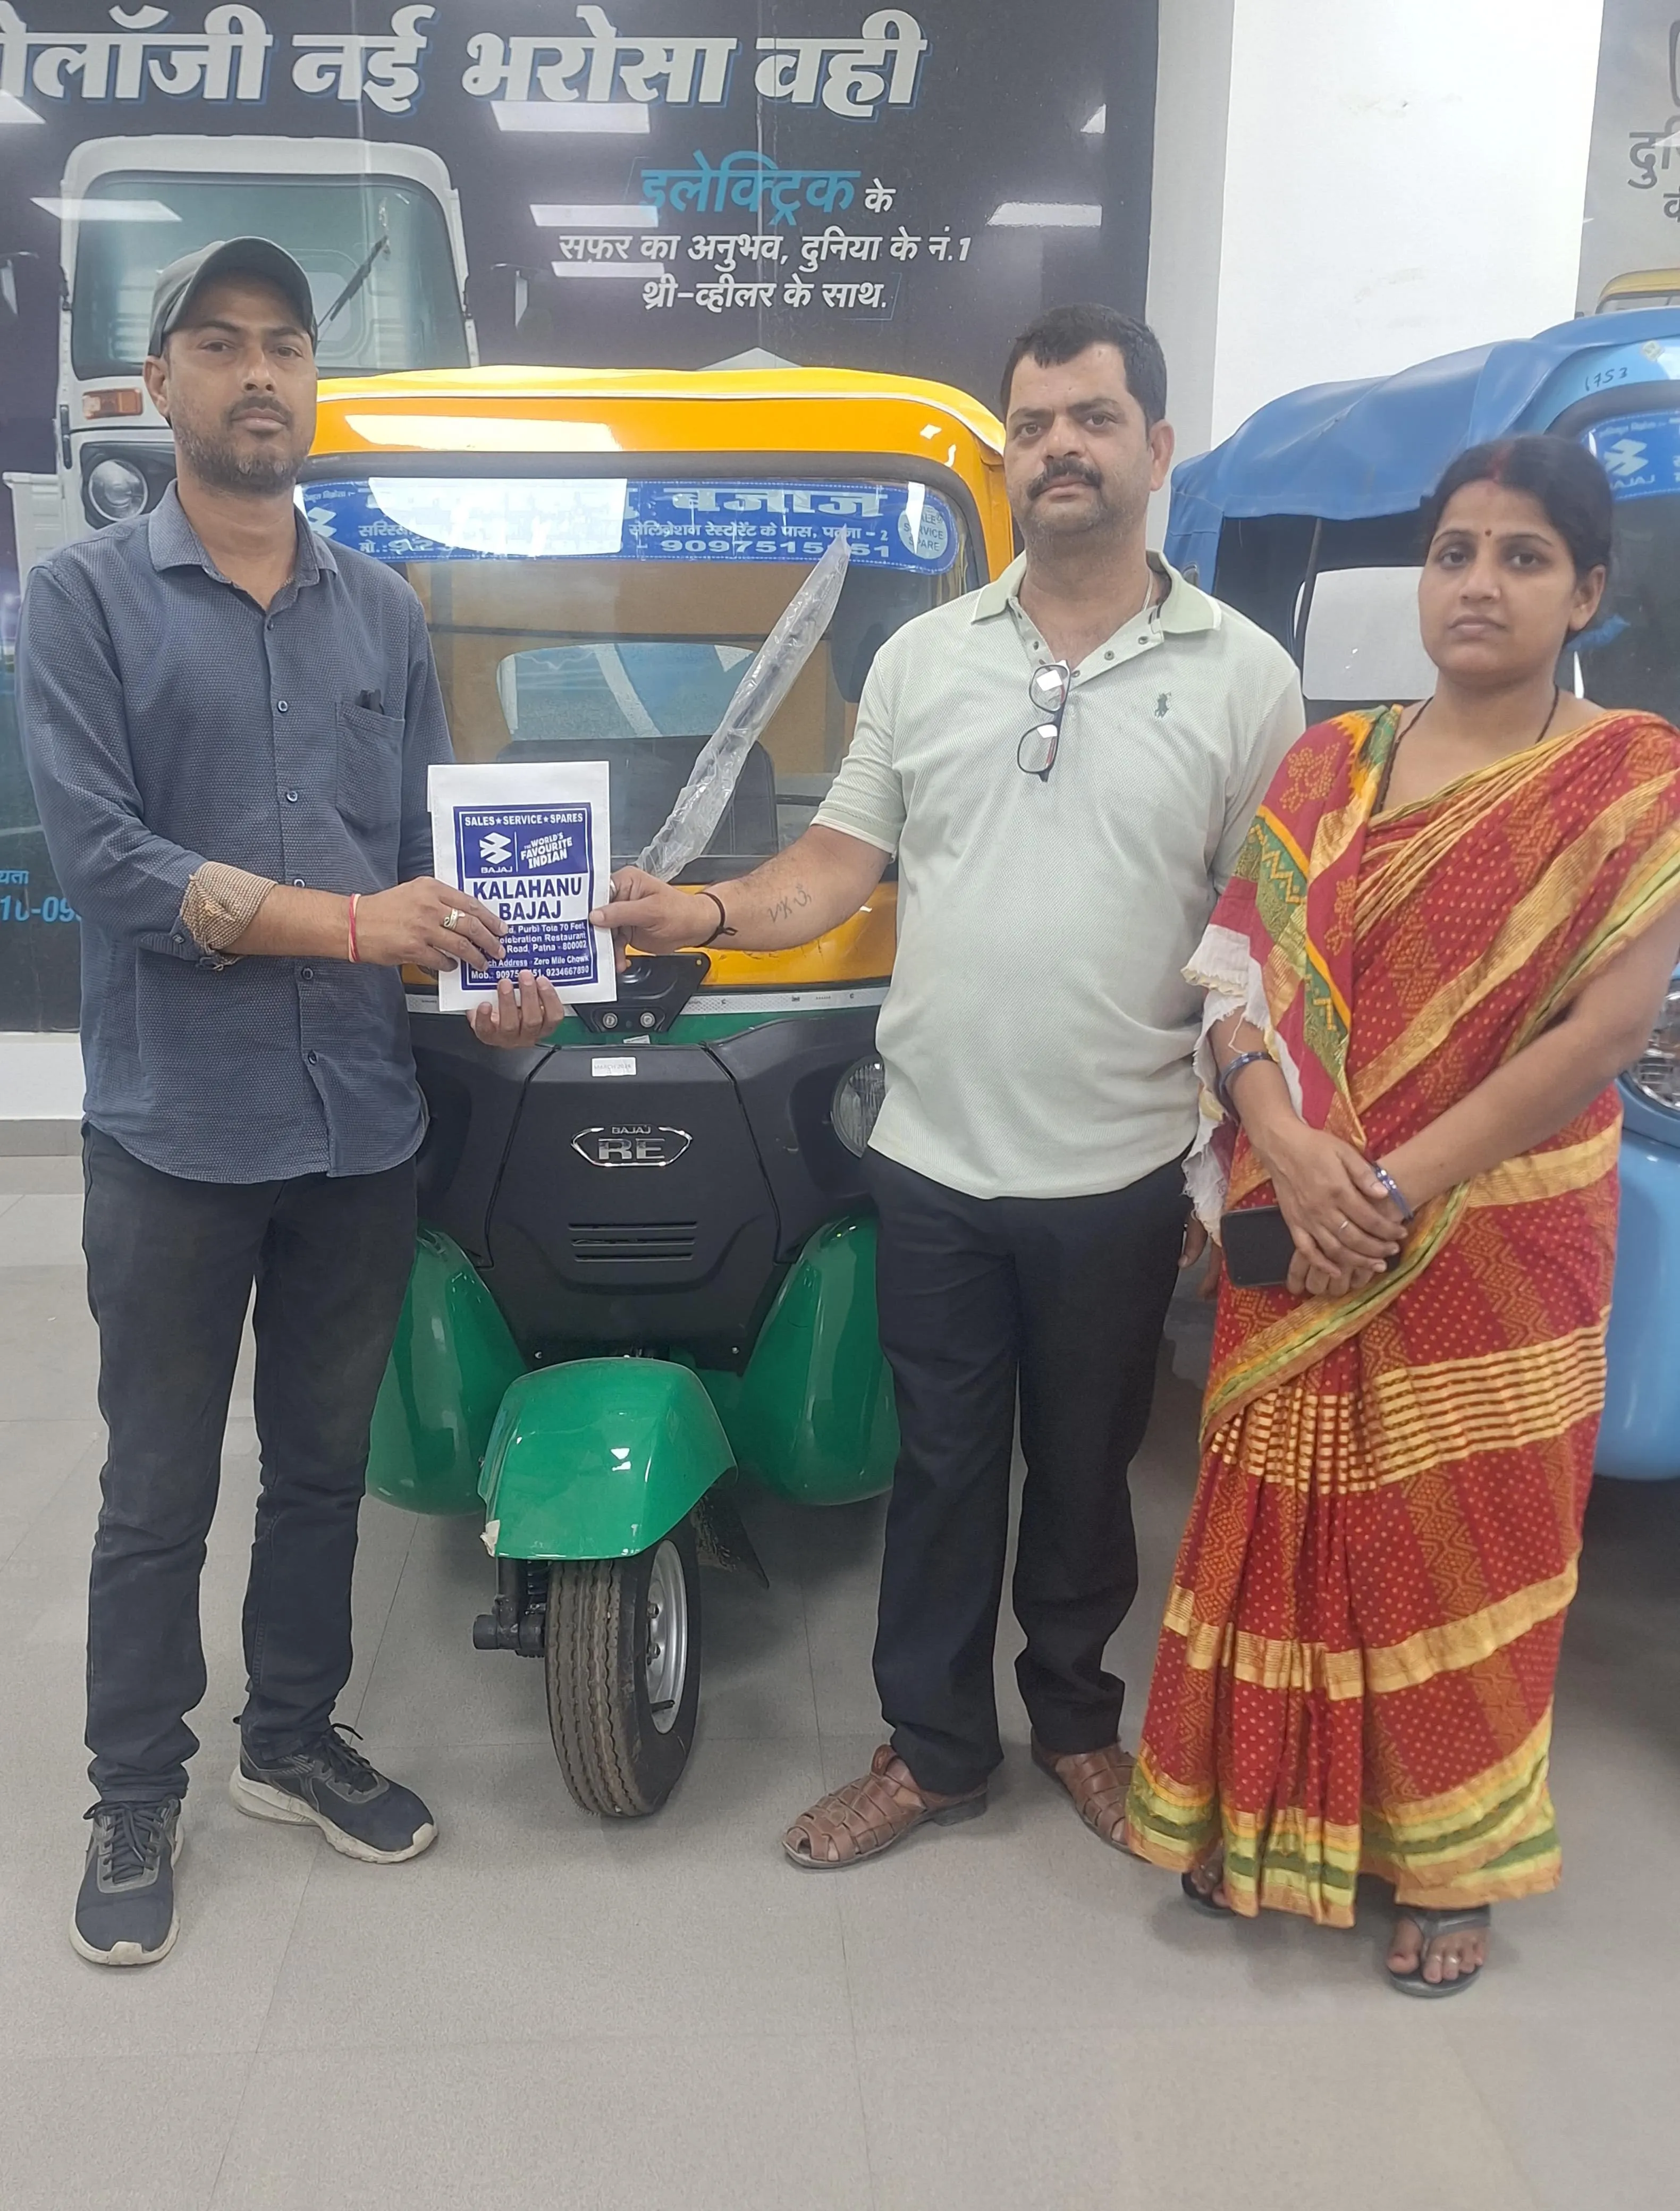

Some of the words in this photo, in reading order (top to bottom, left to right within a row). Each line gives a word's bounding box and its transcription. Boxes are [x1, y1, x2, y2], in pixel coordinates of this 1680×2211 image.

[292, 5, 436, 113] नई
[461, 5, 737, 102] भरोसा
[755, 9, 927, 117] वही
[865, 178, 896, 213] के
[640, 235, 681, 260] का
[687, 233, 789, 272] अनुभव,
[799, 225, 883, 273] दुनिया
[890, 226, 922, 261] के
[783, 273, 815, 308] के
[822, 282, 887, 308] साथ.
[760, 521, 778, 536] के
[661, 540, 889, 558] 909751551
[465, 816, 495, 826] SALES
[503, 814, 543, 825] SERVICE
[550, 813, 583, 823] SPARES
[520, 836, 573, 860] FAVOURITE
[530, 832, 563, 847] WORLD'S
[528, 848, 567, 869] INDIAN
[473, 877, 582, 900] KALAHANU
[499, 900, 561, 921] BAJAJ
[500, 935, 542, 944] elebration
[533, 943, 556, 952] Patna
[498, 958, 528, 967] Address
[612, 1126, 651, 1134] BAJAJ
[598, 1138, 665, 1160] RE
